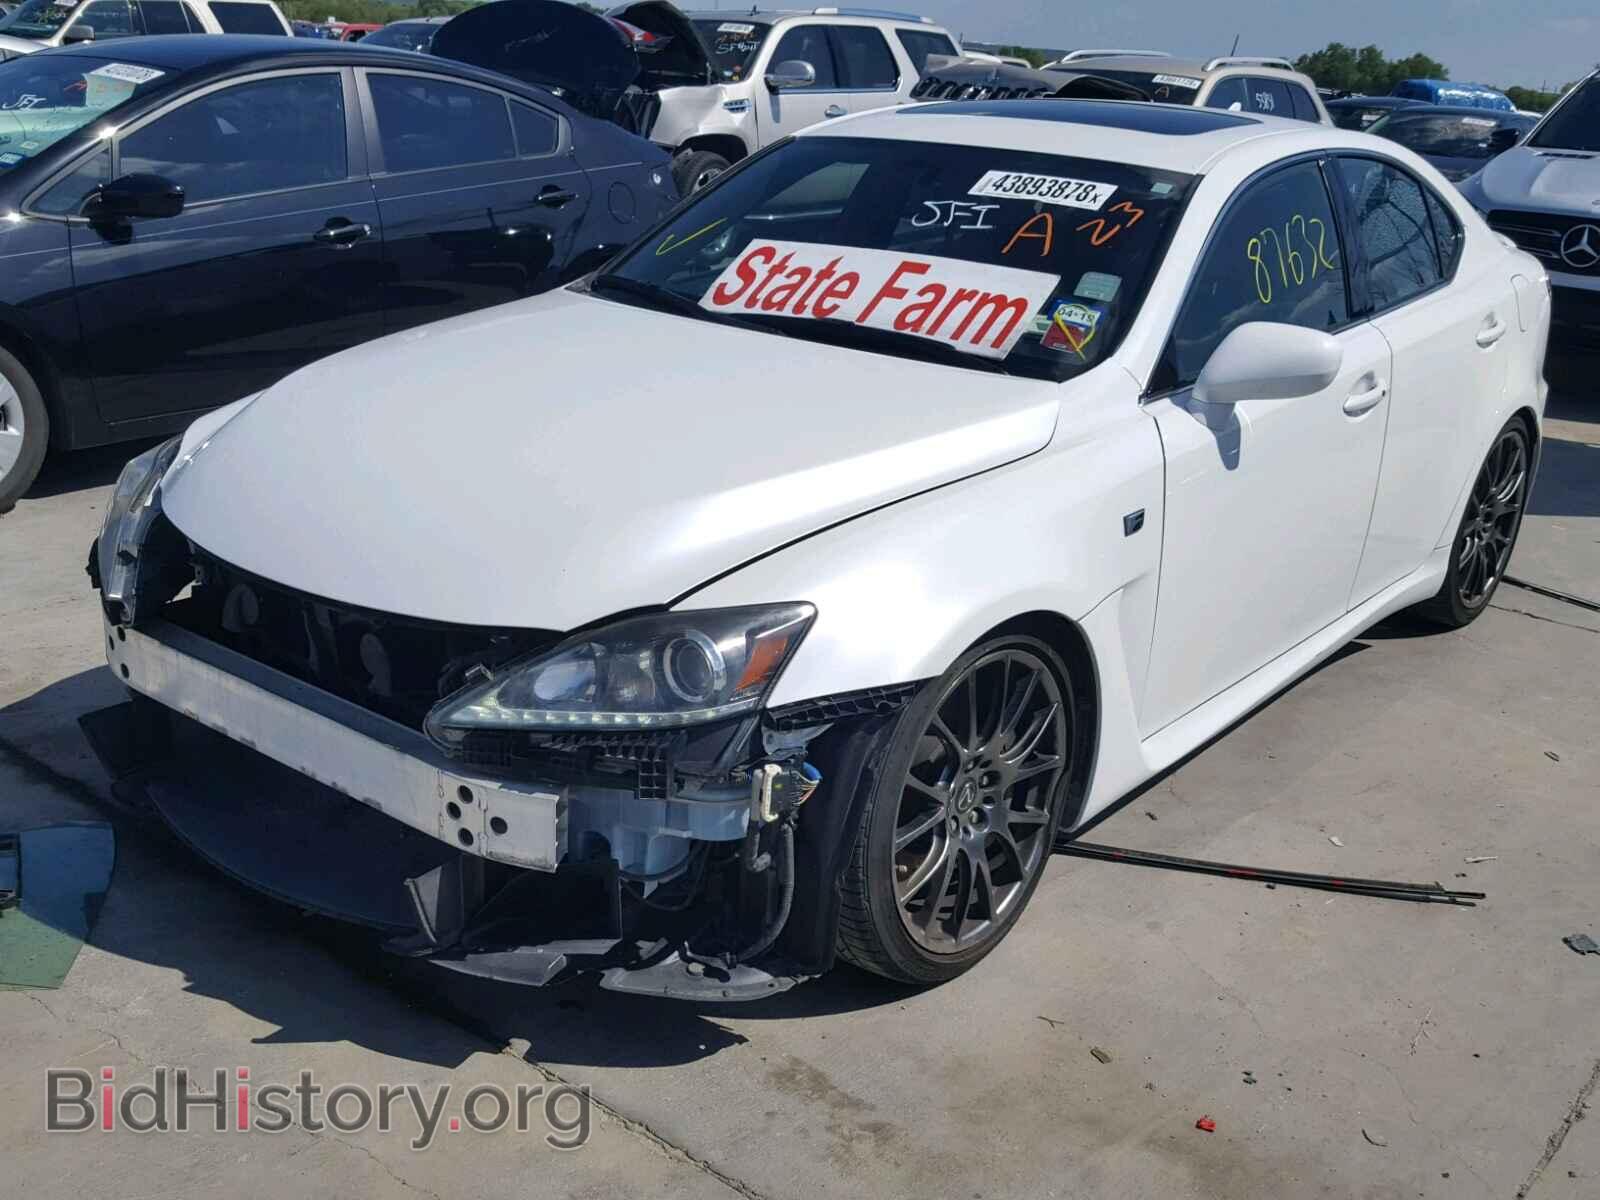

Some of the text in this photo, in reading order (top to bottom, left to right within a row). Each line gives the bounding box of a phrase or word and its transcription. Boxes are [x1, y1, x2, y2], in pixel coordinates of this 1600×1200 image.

[1001, 212, 1053, 256] A
[712, 245, 1029, 349] State Farm
